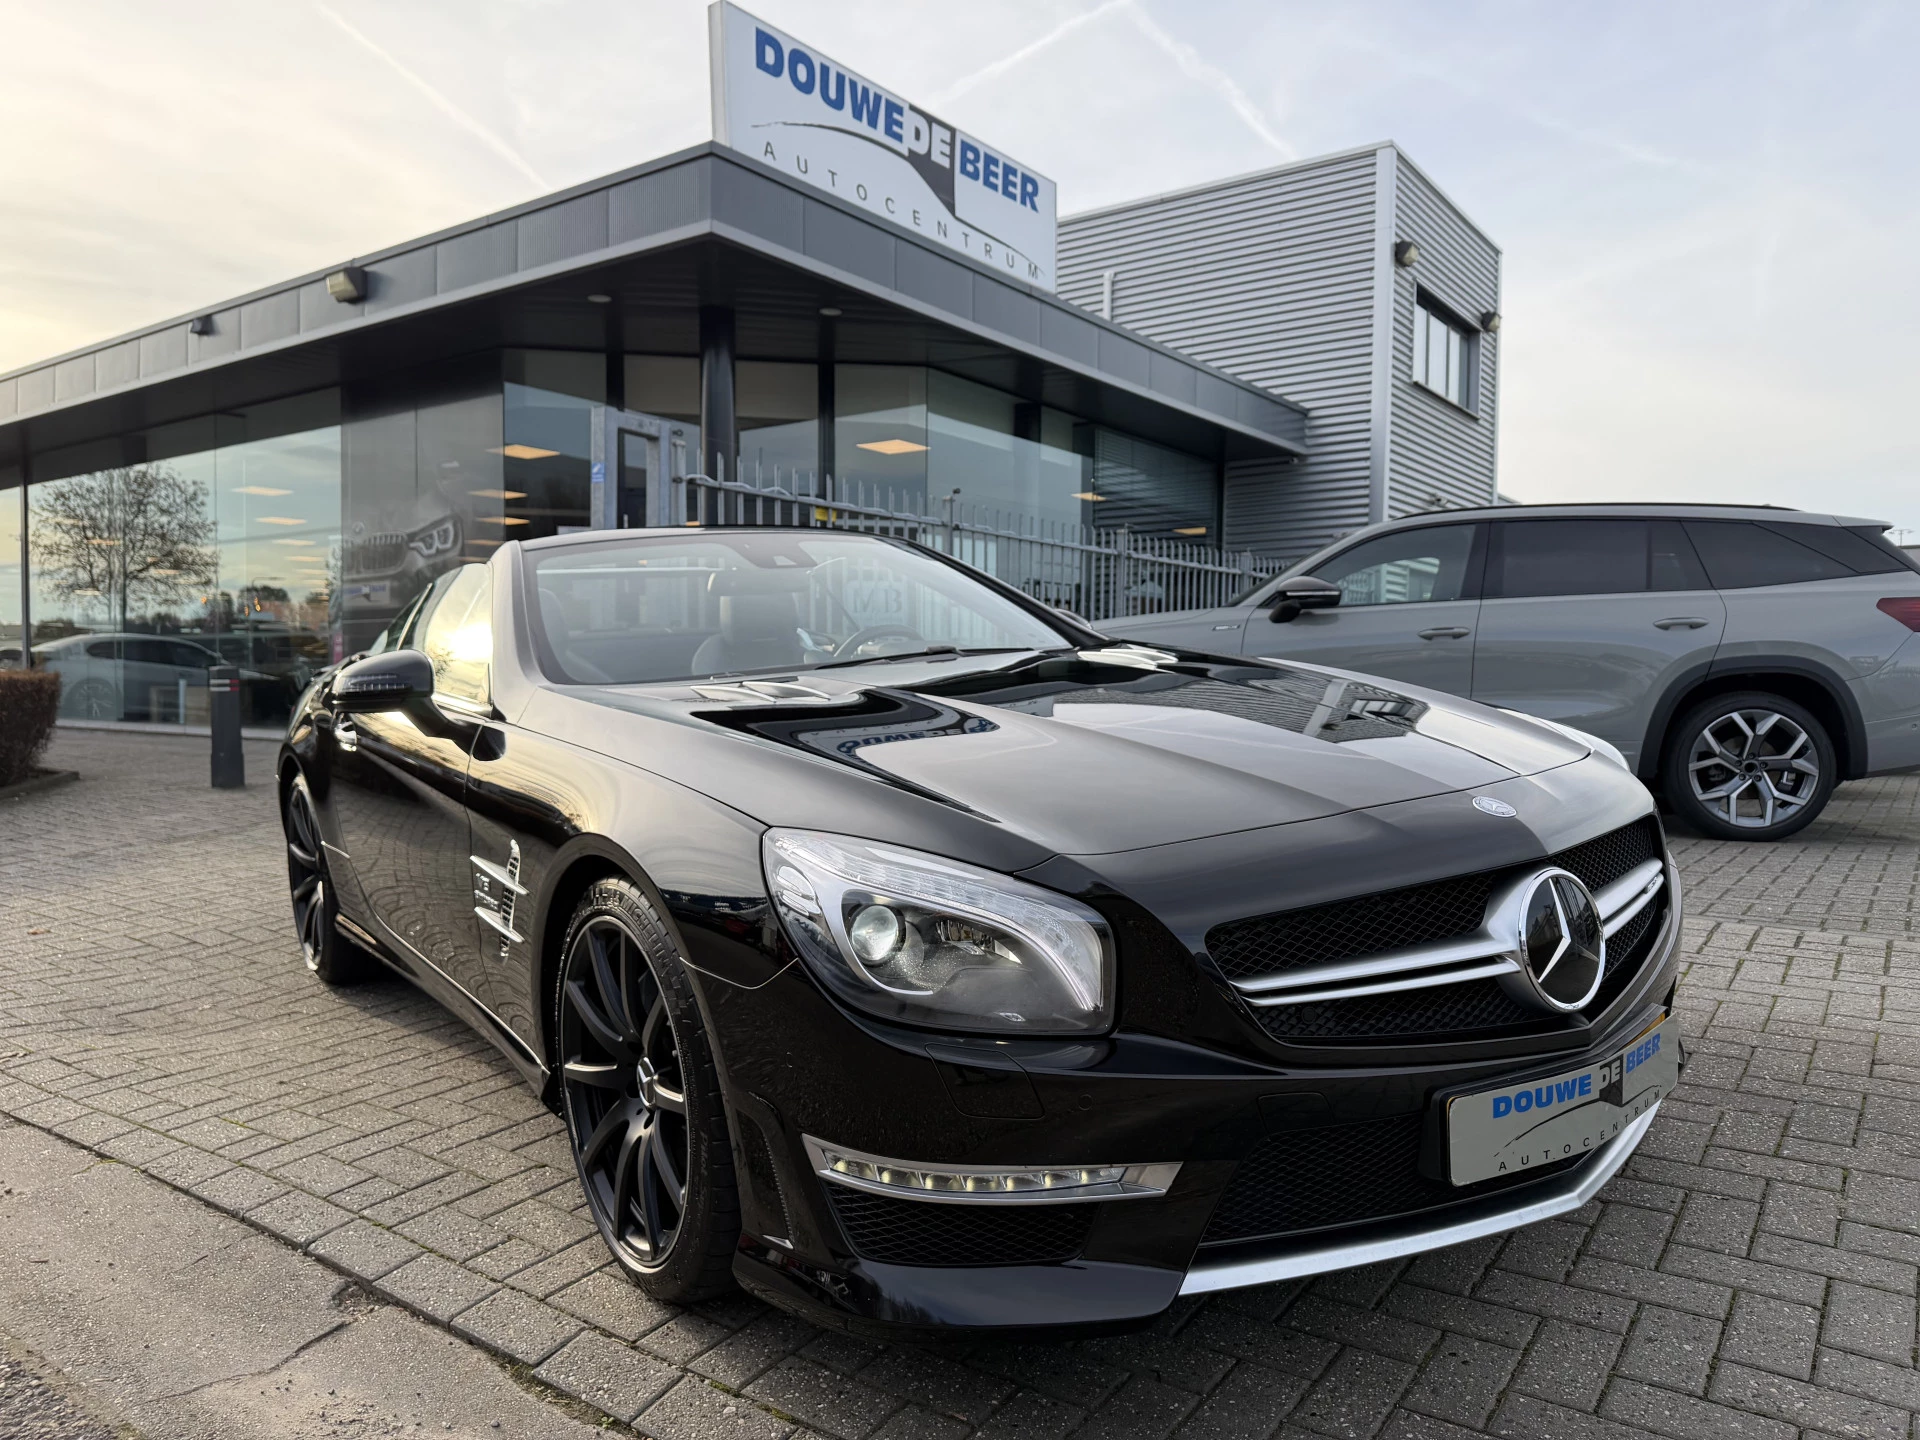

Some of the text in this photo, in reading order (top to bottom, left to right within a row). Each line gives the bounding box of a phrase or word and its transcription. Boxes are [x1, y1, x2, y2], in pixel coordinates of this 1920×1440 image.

[755, 27, 1040, 213] DOUWE DE BEER
[764, 141, 1038, 280] AUTOCENTRUM
[1492, 1033, 1661, 1119] DOUWE DE BEER
[1498, 1089, 1661, 1172] AUTOCENTRUM
